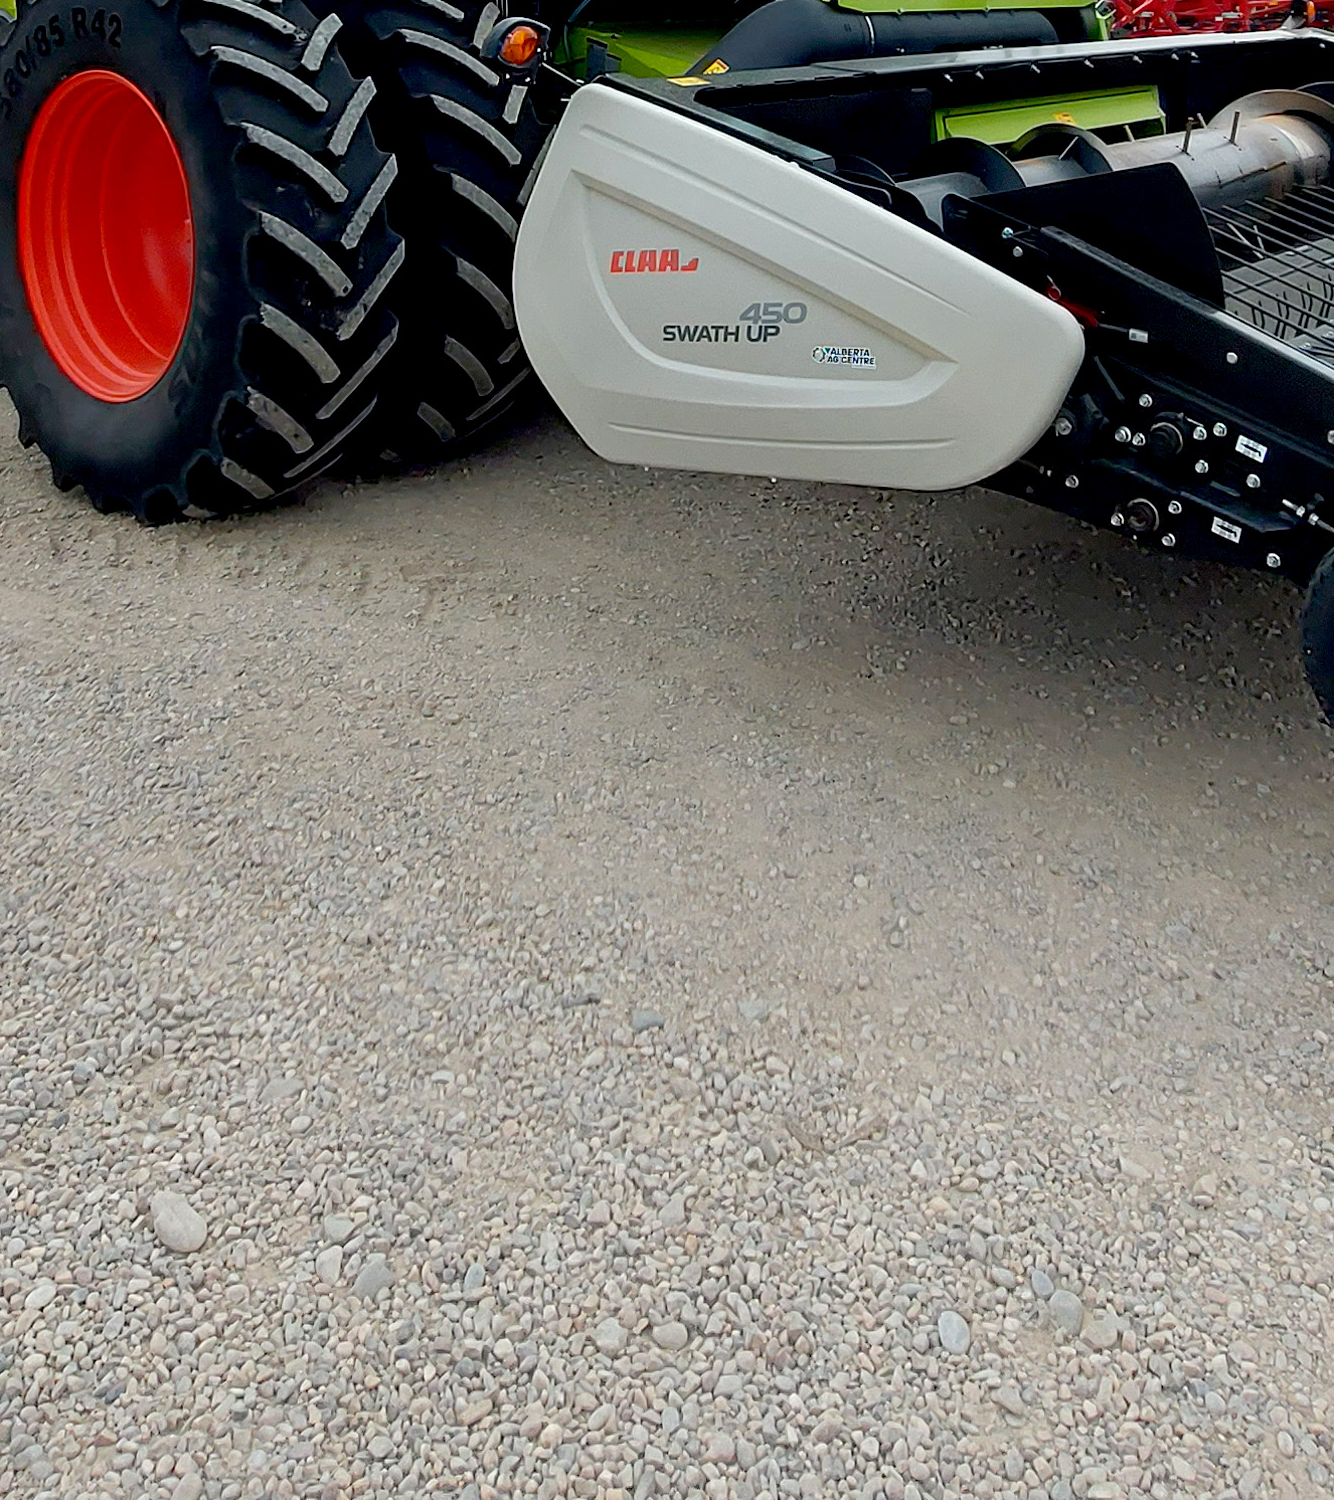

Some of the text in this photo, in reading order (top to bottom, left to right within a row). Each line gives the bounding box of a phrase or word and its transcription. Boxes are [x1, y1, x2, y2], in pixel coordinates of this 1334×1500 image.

[71, 7, 122, 49] R42
[739, 302, 808, 324] 450
[662, 325, 781, 343] SWATH UP
[827, 355, 875, 365] AG CENTRE
[830, 347, 870, 357] ALBERTA
